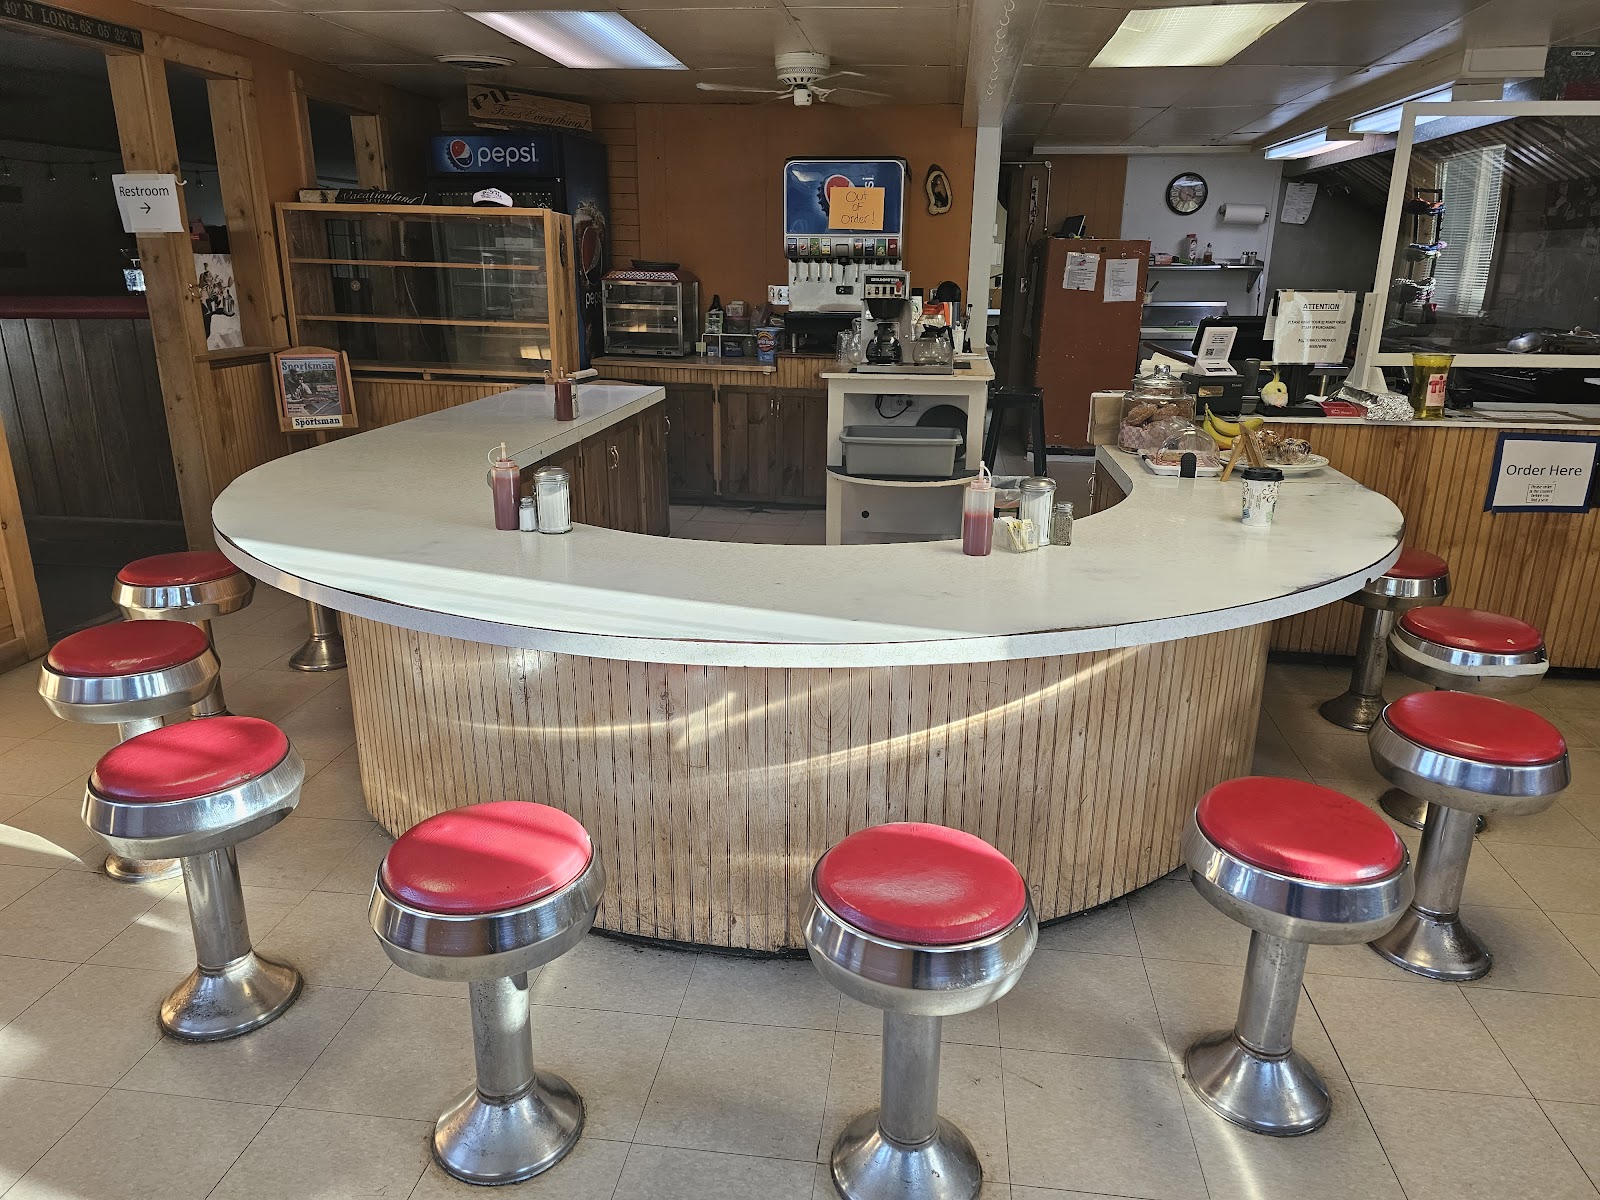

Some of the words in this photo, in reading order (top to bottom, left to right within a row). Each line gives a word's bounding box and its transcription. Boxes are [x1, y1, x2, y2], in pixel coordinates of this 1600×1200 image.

[24, 4, 34, 19] N
[131, 31, 141, 47] W
[491, 103, 522, 119] Fixes
[477, 142, 536, 167] pepsi
[119, 186, 170, 197] Restroom
[340, 190, 420, 204] Vacationland
[846, 191, 868, 202] Out
[281, 362, 335, 370] Sportsman
[295, 418, 340, 427] Sportsman
[1506, 464, 1546, 476] Order
[1549, 465, 1582, 476] Here
